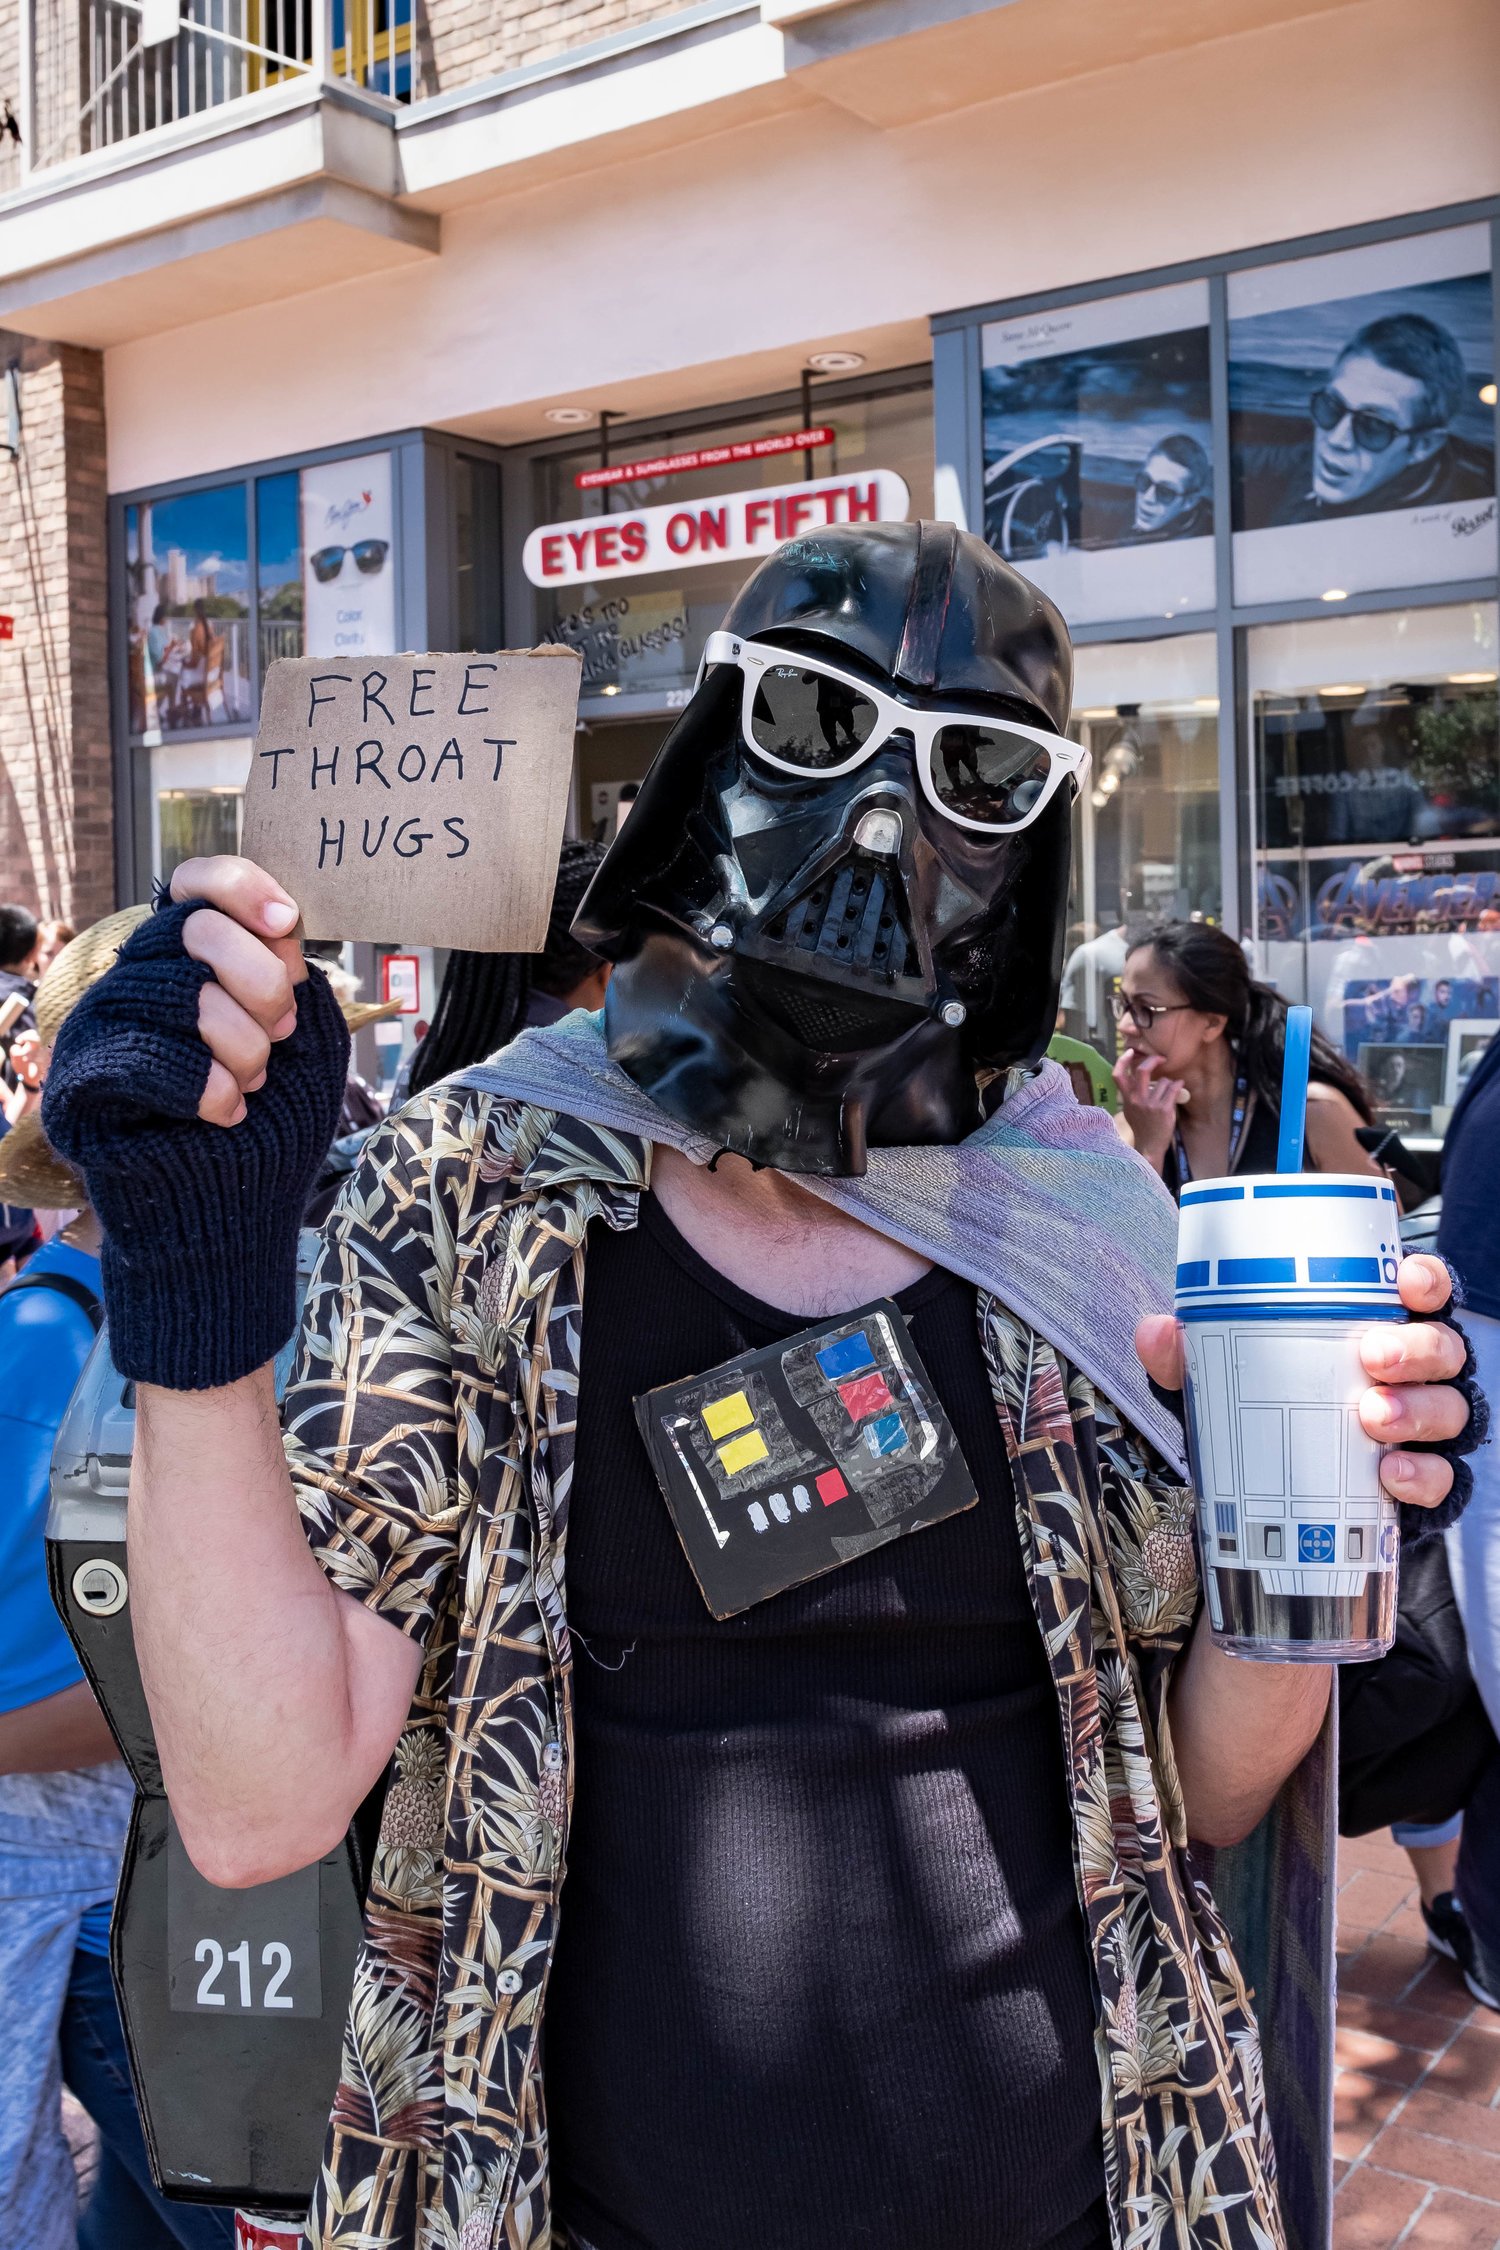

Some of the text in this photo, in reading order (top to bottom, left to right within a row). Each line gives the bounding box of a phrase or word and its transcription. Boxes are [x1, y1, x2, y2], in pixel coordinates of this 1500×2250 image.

[636, 455, 698, 476] SUNGLASSES
[700, 450, 731, 464] FROM
[732, 446, 753, 459] THE
[756, 438, 794, 454] WORLD
[795, 430, 825, 446] OVER
[541, 483, 878, 577] EYES ON FIFTH
[308, 664, 498, 727] FREE
[260, 737, 518, 790] THROAT
[317, 815, 471, 869] HUGS
[194, 1938, 294, 2009] 212
